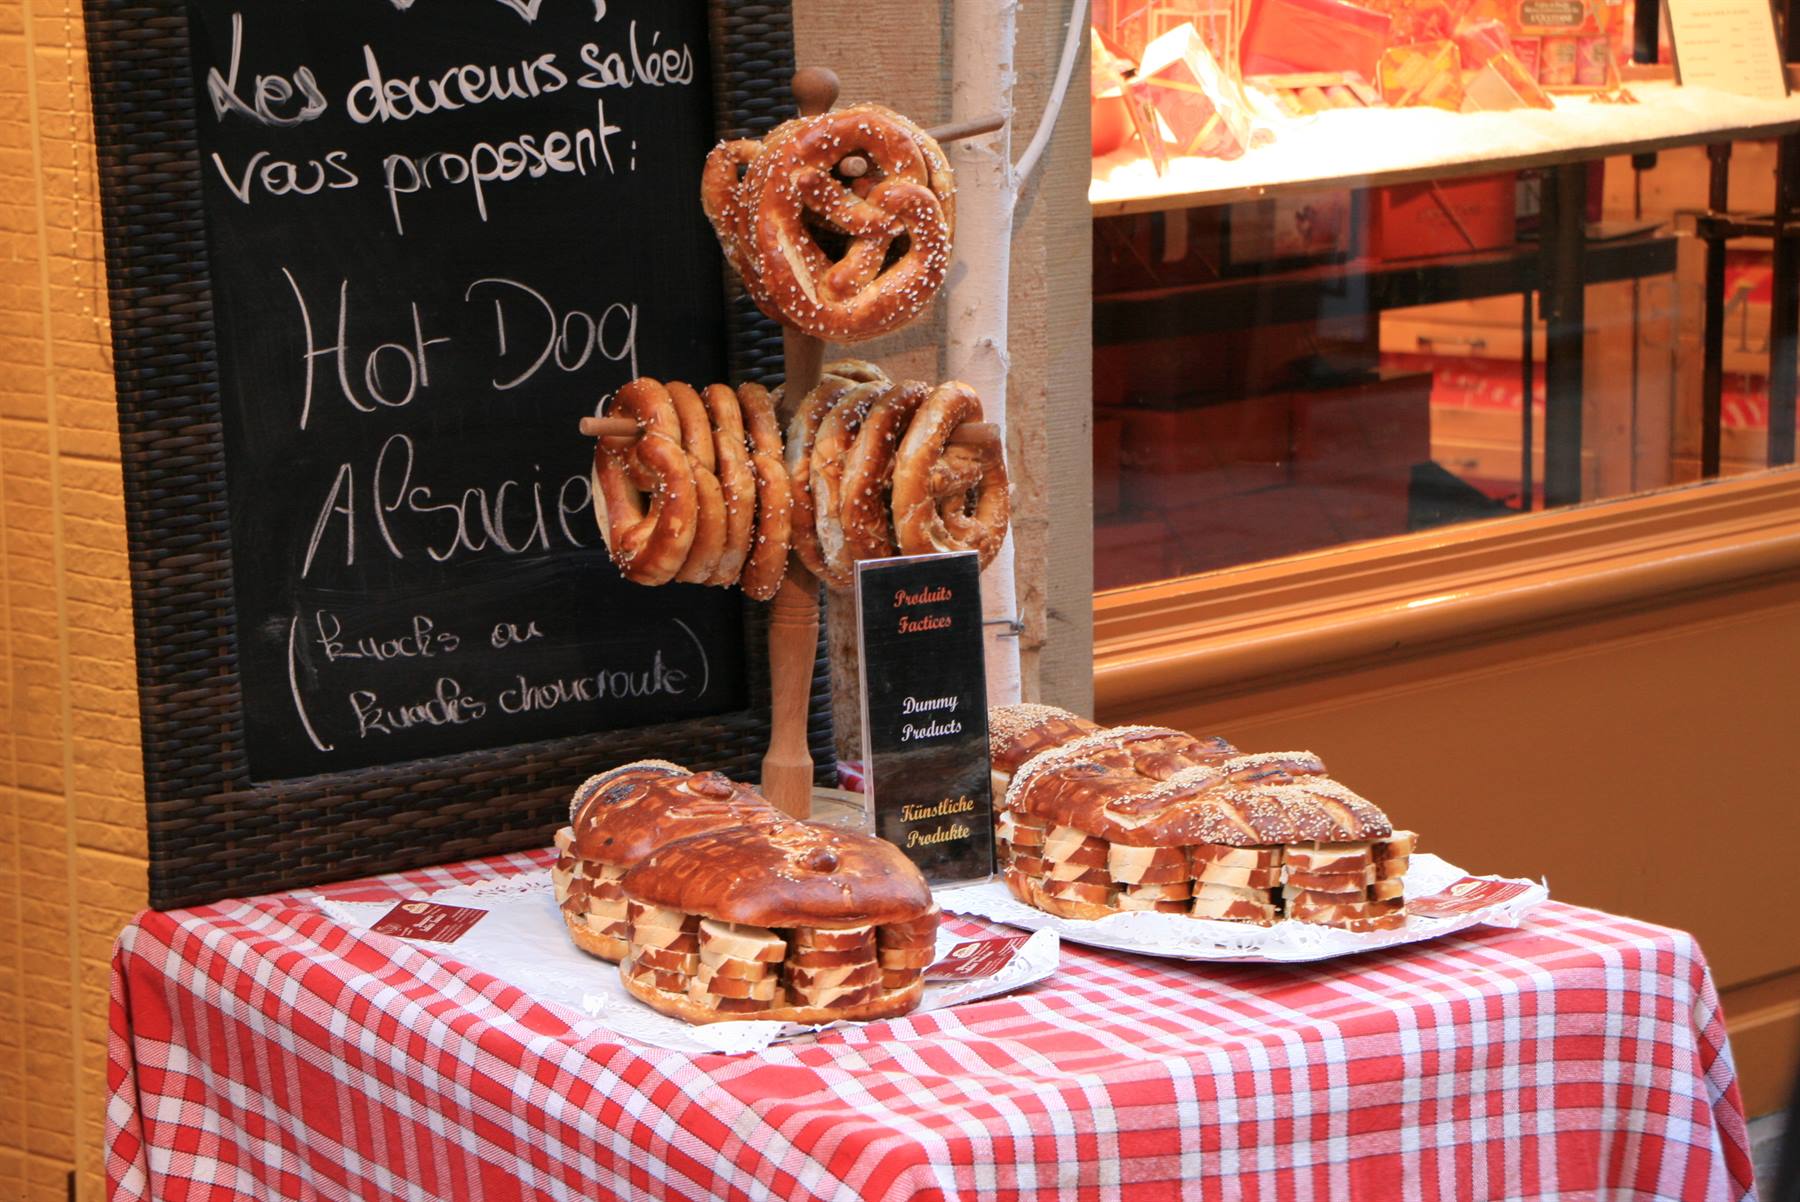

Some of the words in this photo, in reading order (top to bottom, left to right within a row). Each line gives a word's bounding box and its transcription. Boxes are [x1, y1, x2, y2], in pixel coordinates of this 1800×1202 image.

[207, 12, 328, 126] Les
[346, 44, 567, 125] douceurs
[577, 19, 695, 90] salées
[301, 433, 595, 580] Alsacie
[893, 585, 953, 608] Produits
[897, 614, 952, 634] Factices
[902, 694, 959, 716] Dummy
[901, 718, 962, 742] Products
[900, 795, 974, 824] Künstliche
[906, 825, 970, 849] Produkte
